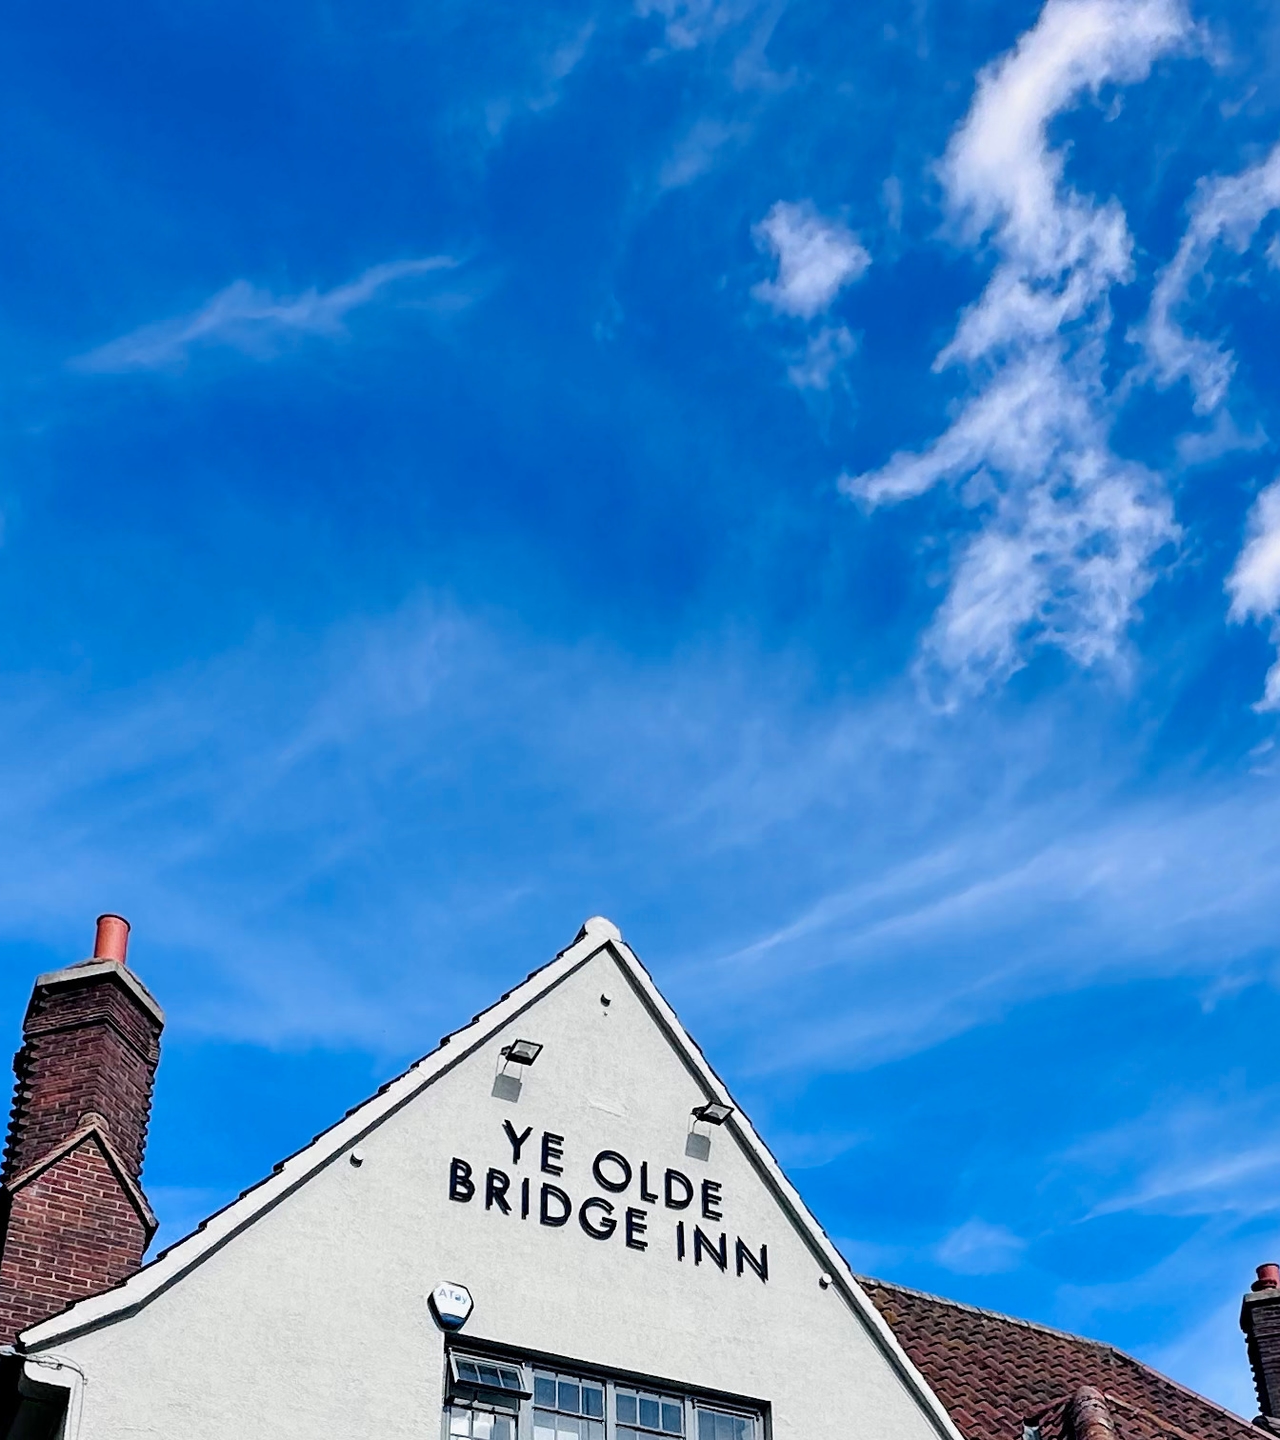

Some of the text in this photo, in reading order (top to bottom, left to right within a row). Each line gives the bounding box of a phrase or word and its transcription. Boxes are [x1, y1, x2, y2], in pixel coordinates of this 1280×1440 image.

[448, 1156, 769, 1284] BRIDGE INN
[501, 1119, 723, 1222] YE OLDE
